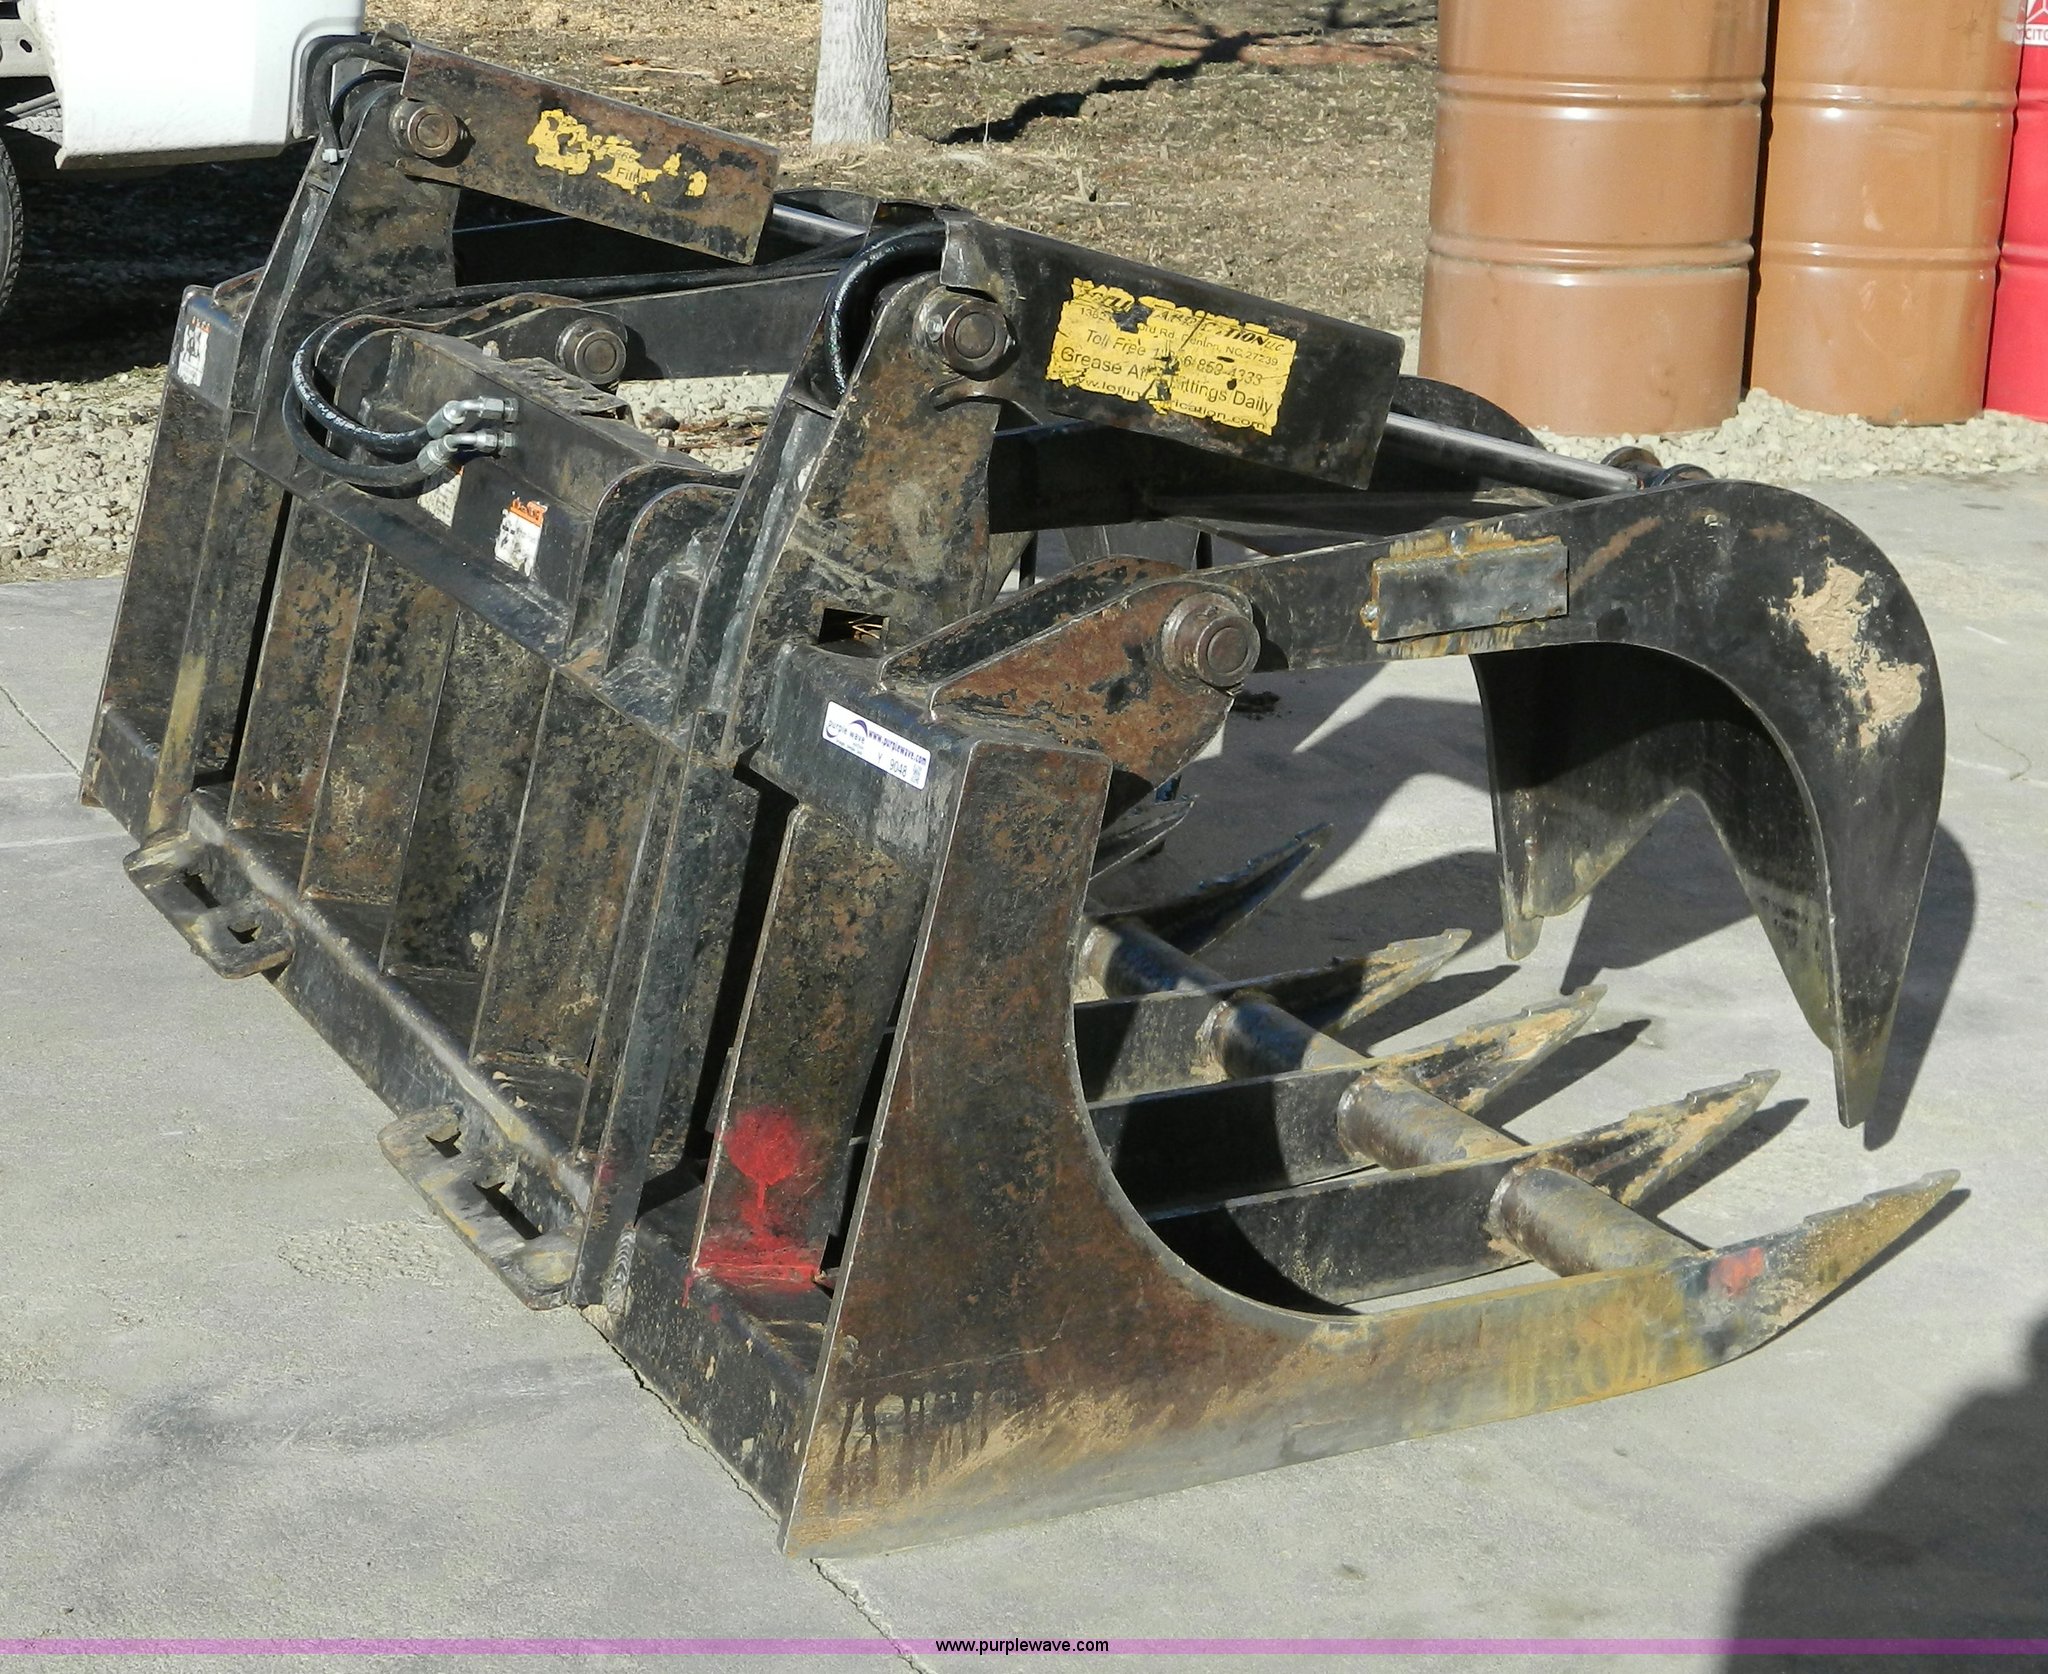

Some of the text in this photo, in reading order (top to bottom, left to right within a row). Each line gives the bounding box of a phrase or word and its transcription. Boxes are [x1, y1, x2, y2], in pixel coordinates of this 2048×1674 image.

[1087, 329, 1111, 347] Toll
[1112, 337, 1147, 356] Free
[1061, 346, 1123, 375] Grease
[1232, 390, 1274, 415] Daily
